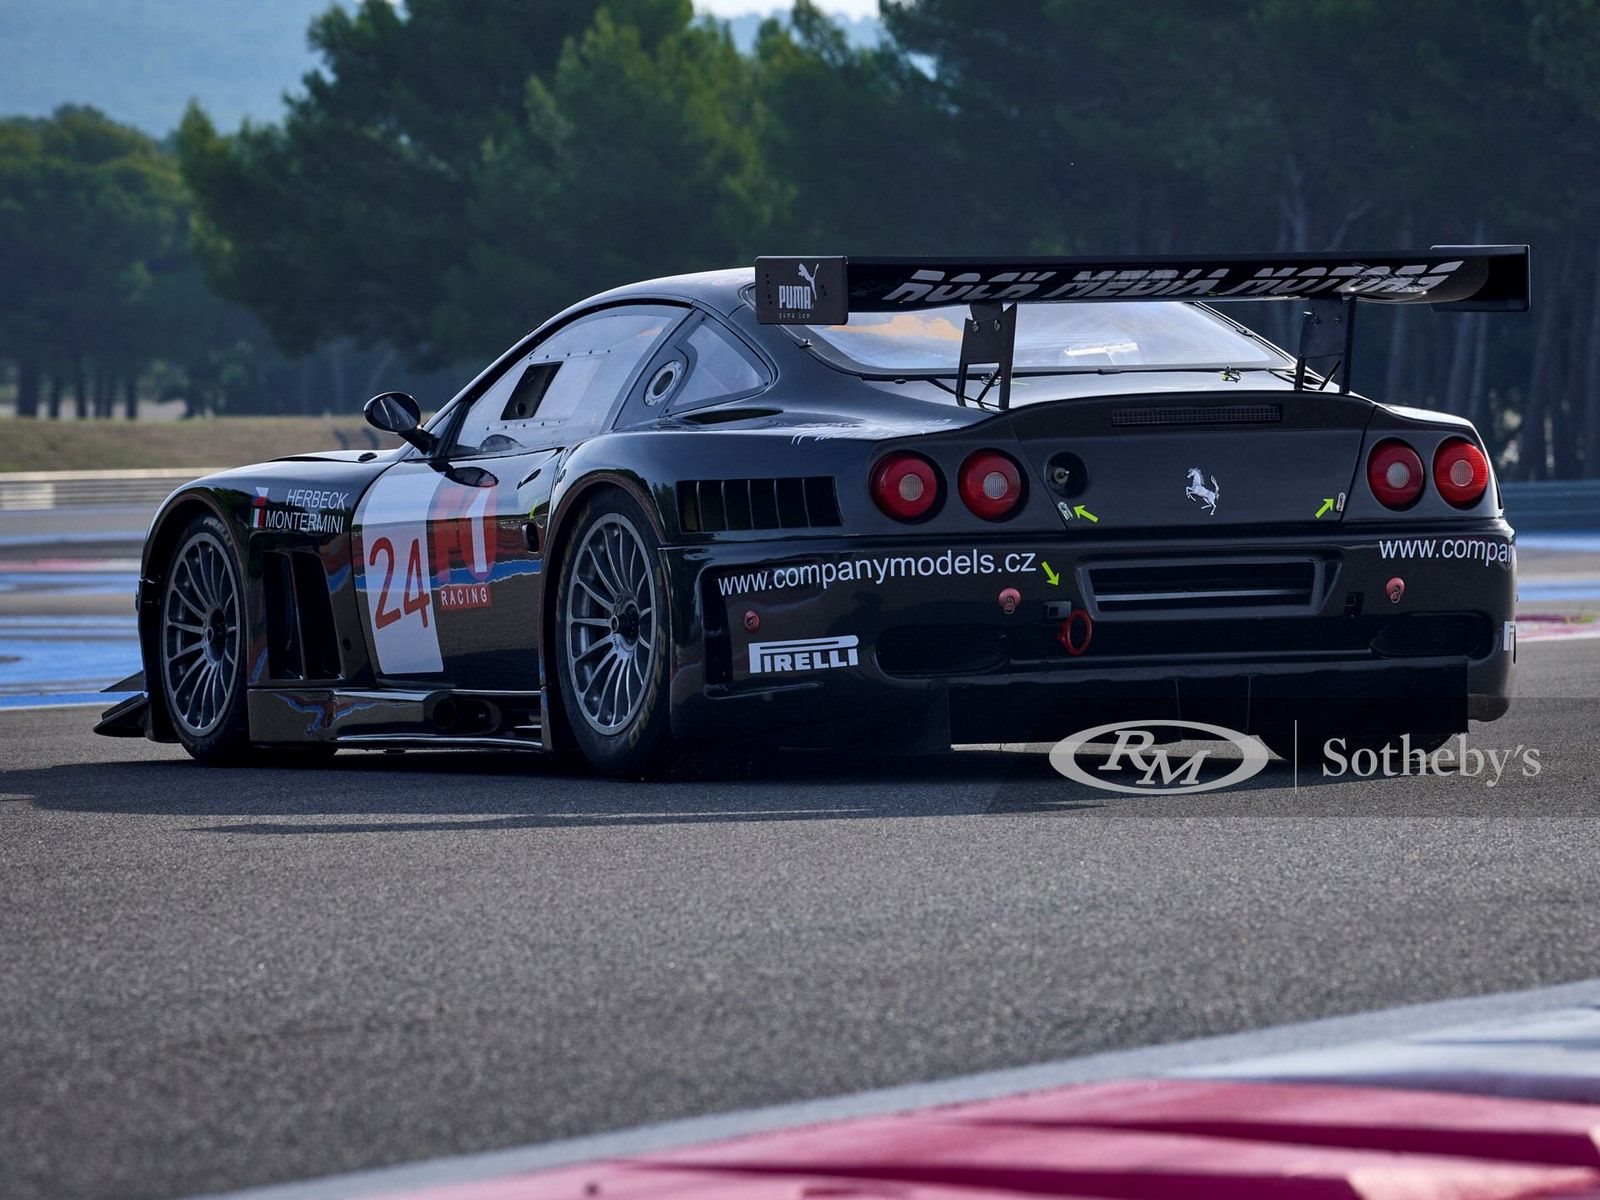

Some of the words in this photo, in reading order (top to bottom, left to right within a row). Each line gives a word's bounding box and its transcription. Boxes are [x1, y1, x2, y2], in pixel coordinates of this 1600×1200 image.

[778, 285, 812, 310] PUMA
[285, 488, 349, 511] HERBECK
[265, 510, 345, 535] MONTERMINI
[369, 536, 431, 631] 24
[717, 548, 1037, 597] www.companymodels.cz
[440, 586, 489, 606] RACING
[747, 634, 860, 674] PIRELLI
